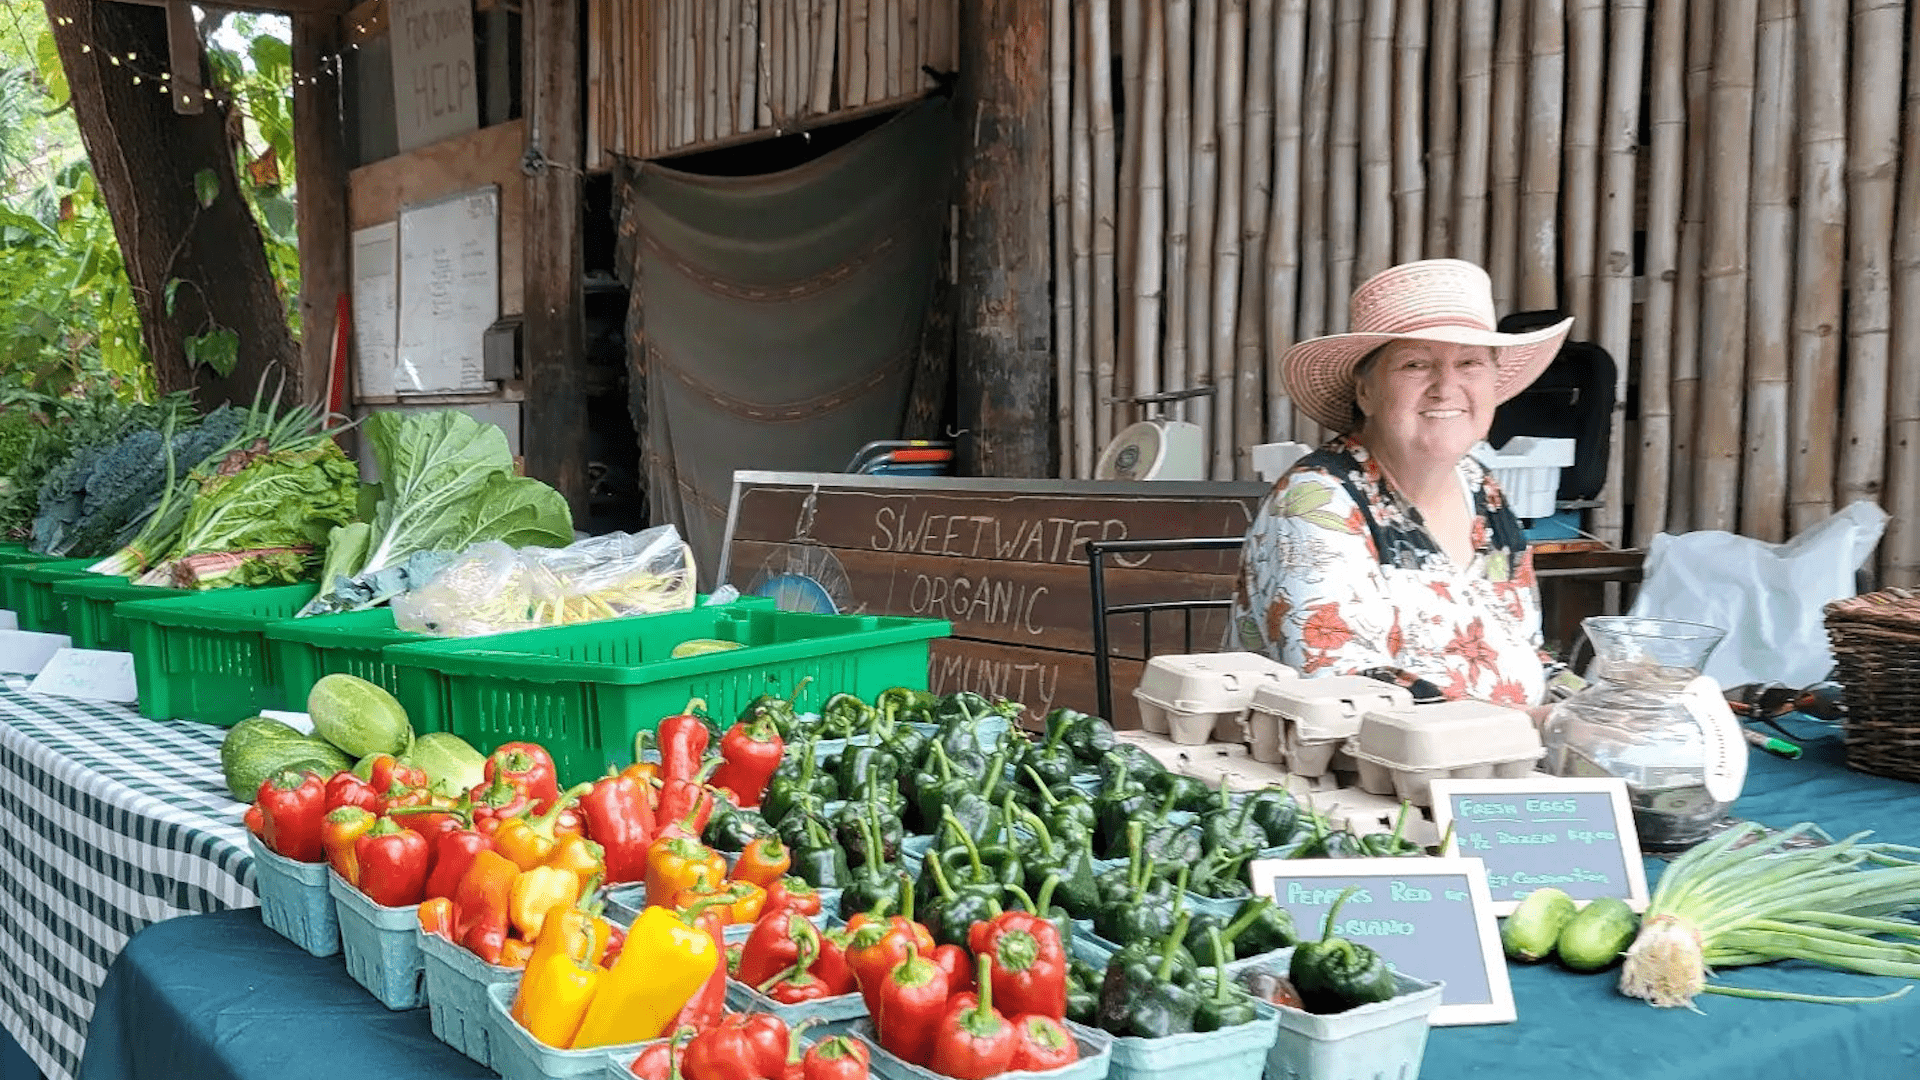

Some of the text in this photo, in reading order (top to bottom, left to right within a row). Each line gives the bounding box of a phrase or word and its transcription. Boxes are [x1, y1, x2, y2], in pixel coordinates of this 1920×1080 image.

[414, 59, 471, 127] HELP
[871, 503, 1151, 568] SWEETWATER
[910, 574, 1048, 635] ORGANIC
